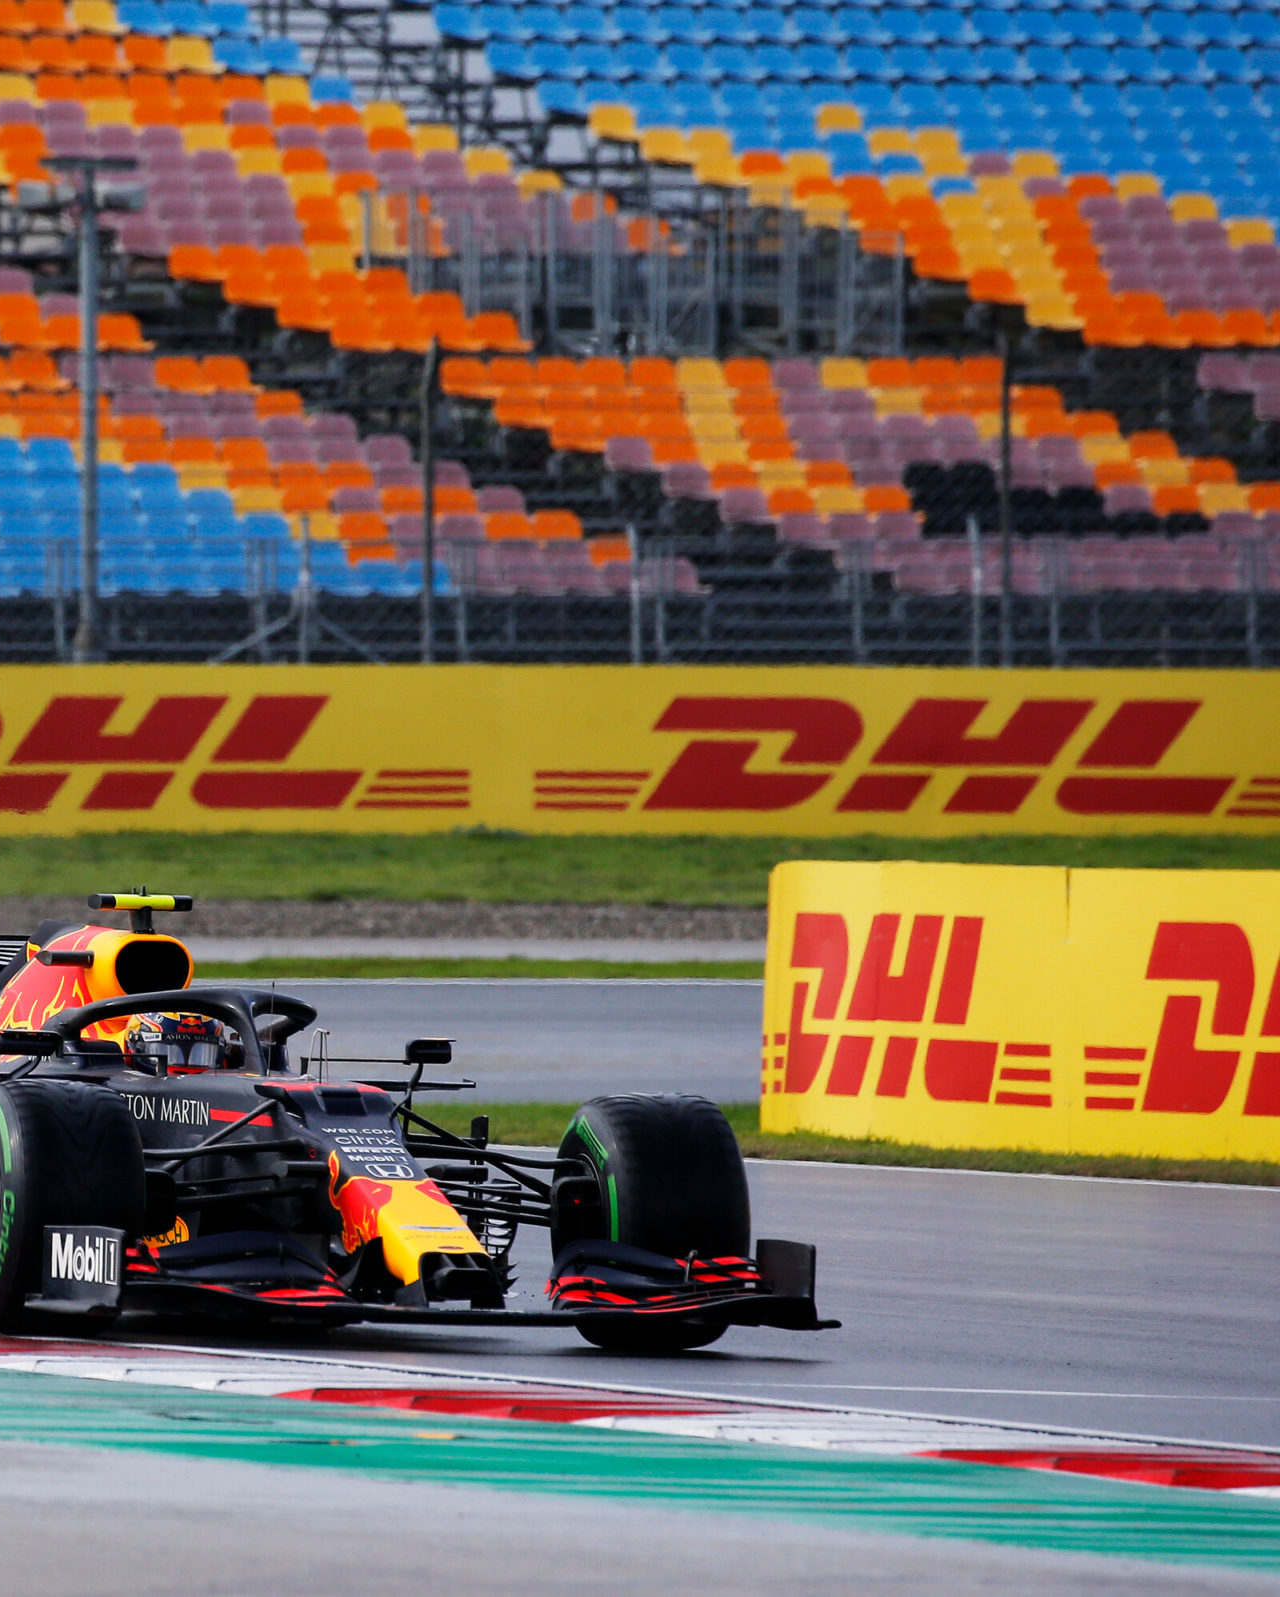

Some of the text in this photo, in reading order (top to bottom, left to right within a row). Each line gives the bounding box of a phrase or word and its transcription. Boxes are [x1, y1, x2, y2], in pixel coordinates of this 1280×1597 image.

[642, 695, 1237, 816] DHL
[784, 912, 999, 1103] DHL
[121, 1093, 210, 1126] TON MARTIN
[335, 1135, 400, 1146] citrix
[340, 1146, 406, 1154] PIRELLI
[347, 1154, 395, 1162] Mobil
[50, 1232, 104, 1284] Mobil
